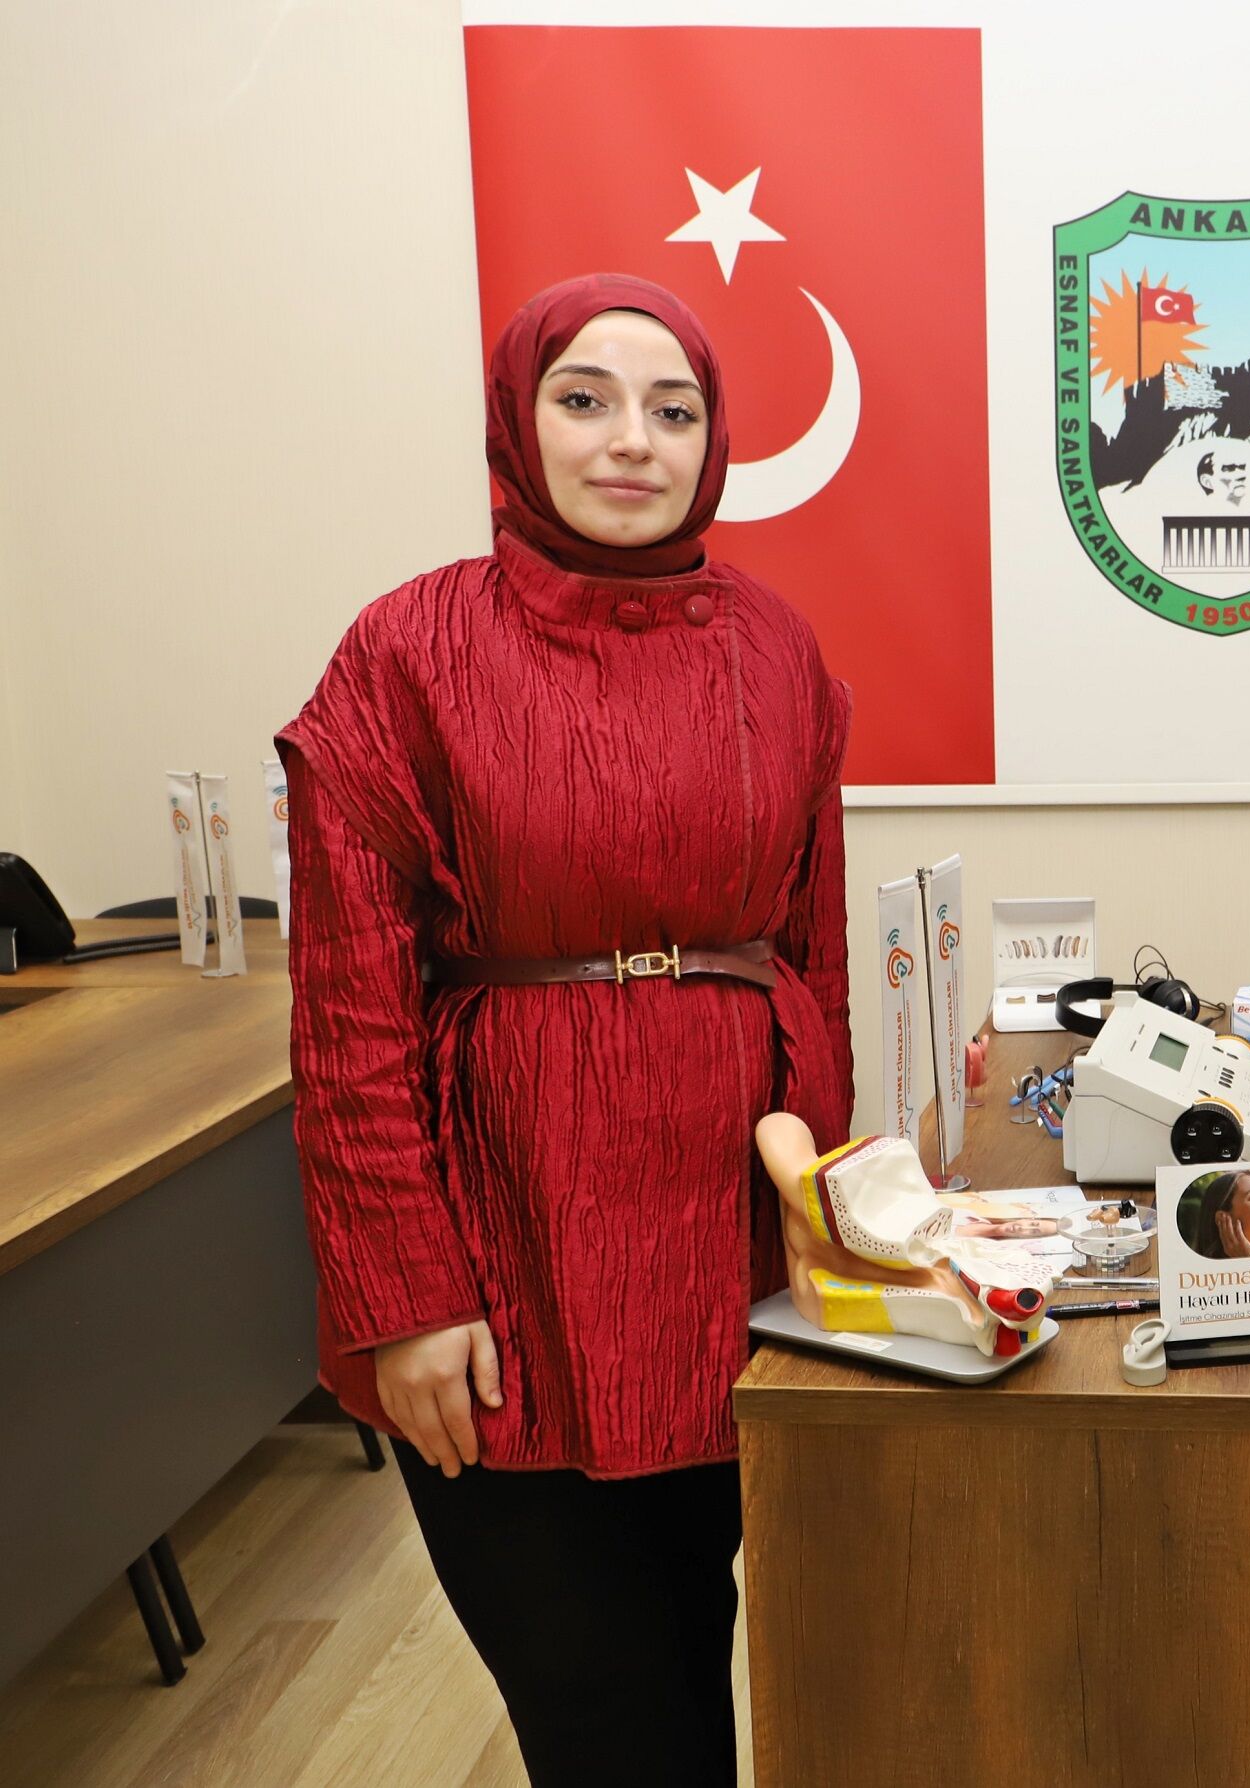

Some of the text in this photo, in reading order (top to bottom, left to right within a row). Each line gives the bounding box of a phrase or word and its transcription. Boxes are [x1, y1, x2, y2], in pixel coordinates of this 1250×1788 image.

[1059, 255, 1079, 353] ESNAF
[1060, 366, 1080, 404] VE
[1061, 417, 1164, 605] SANATKARLAR
[1179, 1293, 1230, 1311] Hayatı
